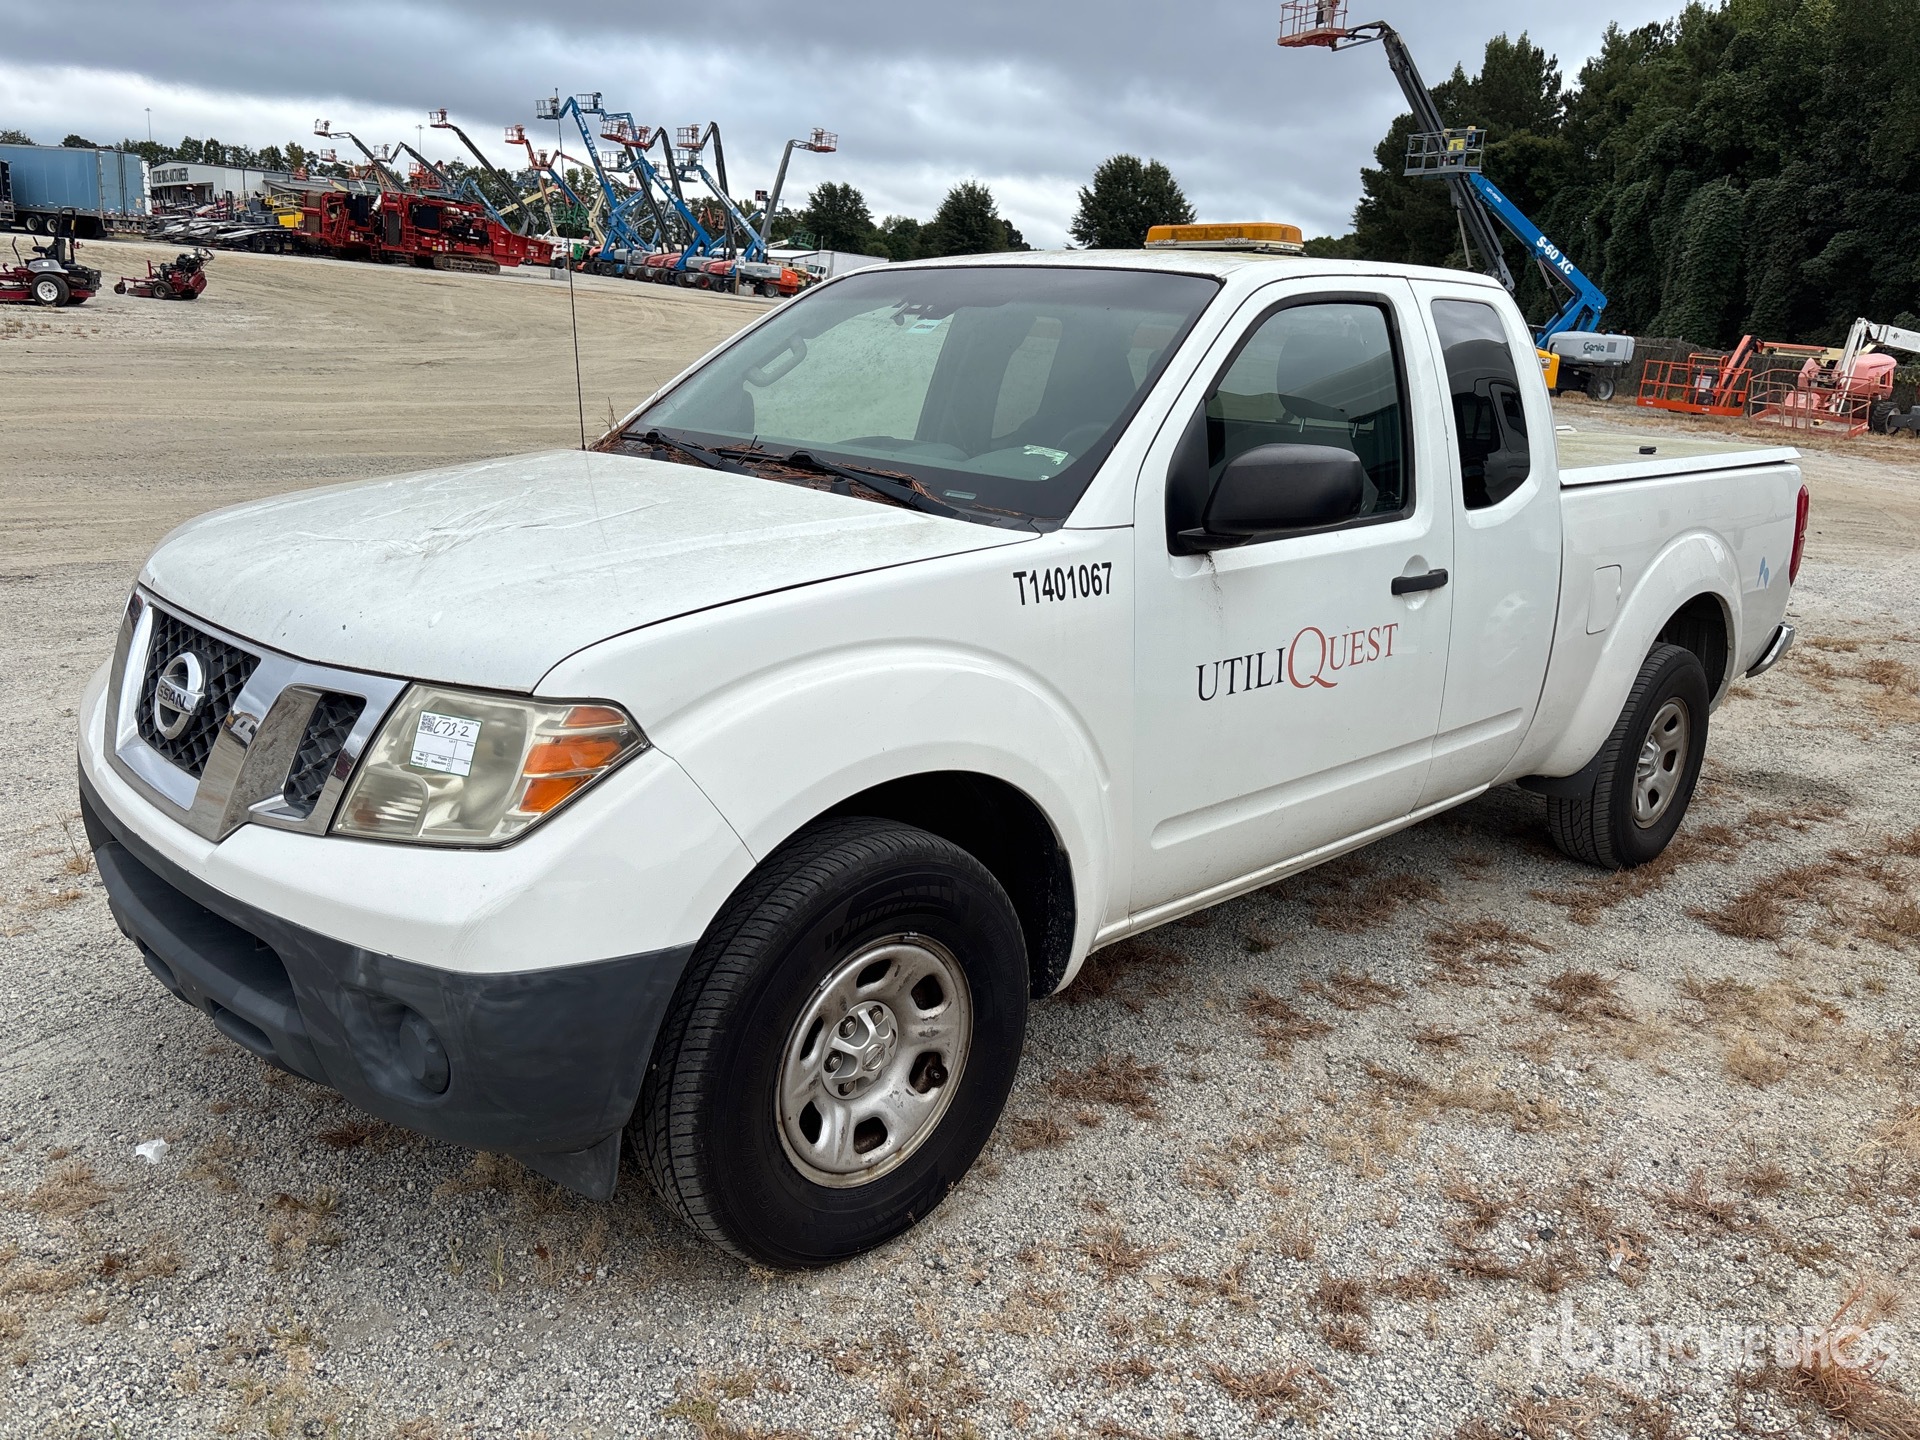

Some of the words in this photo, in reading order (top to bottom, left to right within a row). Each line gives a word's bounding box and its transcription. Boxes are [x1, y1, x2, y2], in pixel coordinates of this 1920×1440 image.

[1536, 235, 1560, 261] S-60
[1557, 256, 1574, 275] XC
[1583, 341, 1605, 352] Genie
[1013, 562, 1113, 606] T1401067
